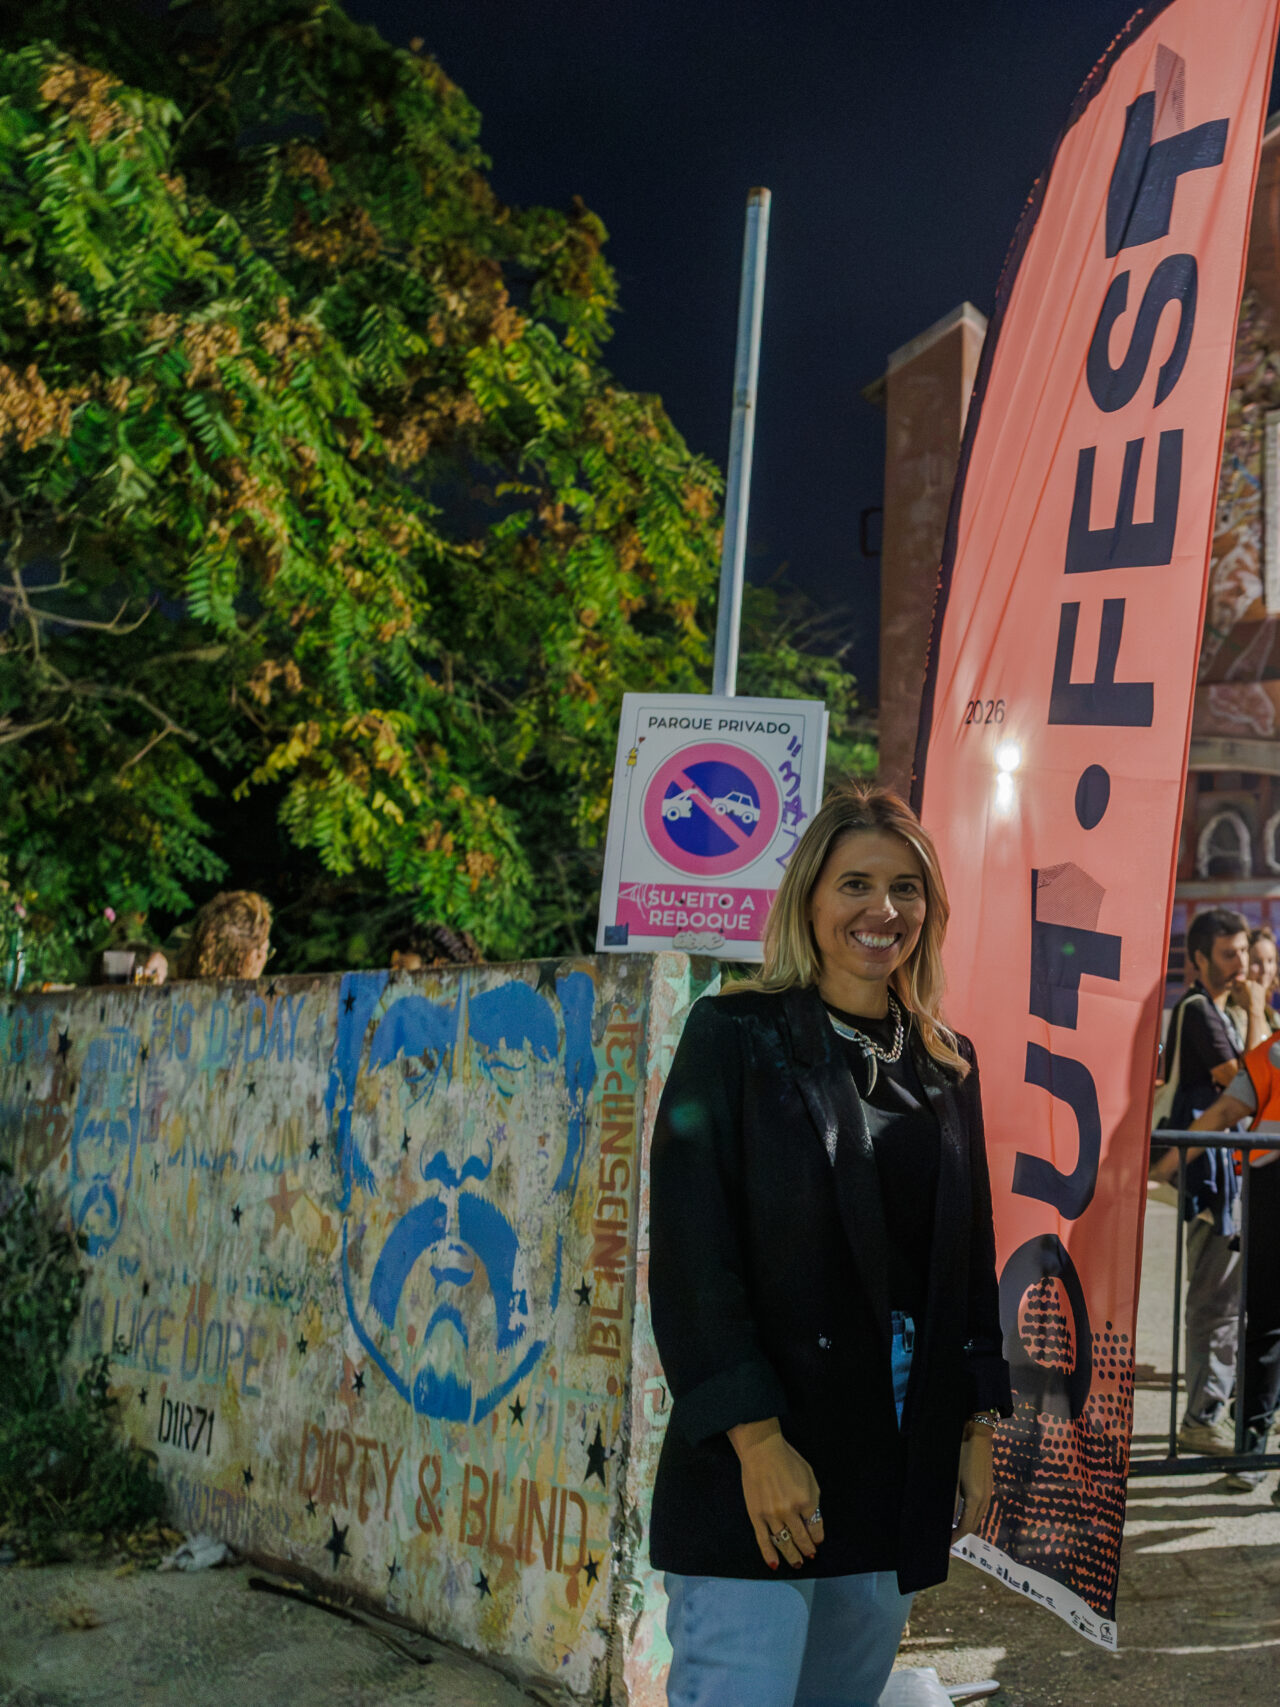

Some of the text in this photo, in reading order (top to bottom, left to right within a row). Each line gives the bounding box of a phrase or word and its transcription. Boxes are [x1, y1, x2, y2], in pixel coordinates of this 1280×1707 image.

[965, 699, 1006, 724] 2026
[648, 716, 791, 734] PARQUE PRIVADO
[648, 890, 755, 911] SUJEITO A
[648, 911, 751, 930] REBOQUE
[299, 1422, 404, 1524] DIRTY
[415, 1454, 444, 1537] &
[458, 1462, 589, 1577] BLIND
